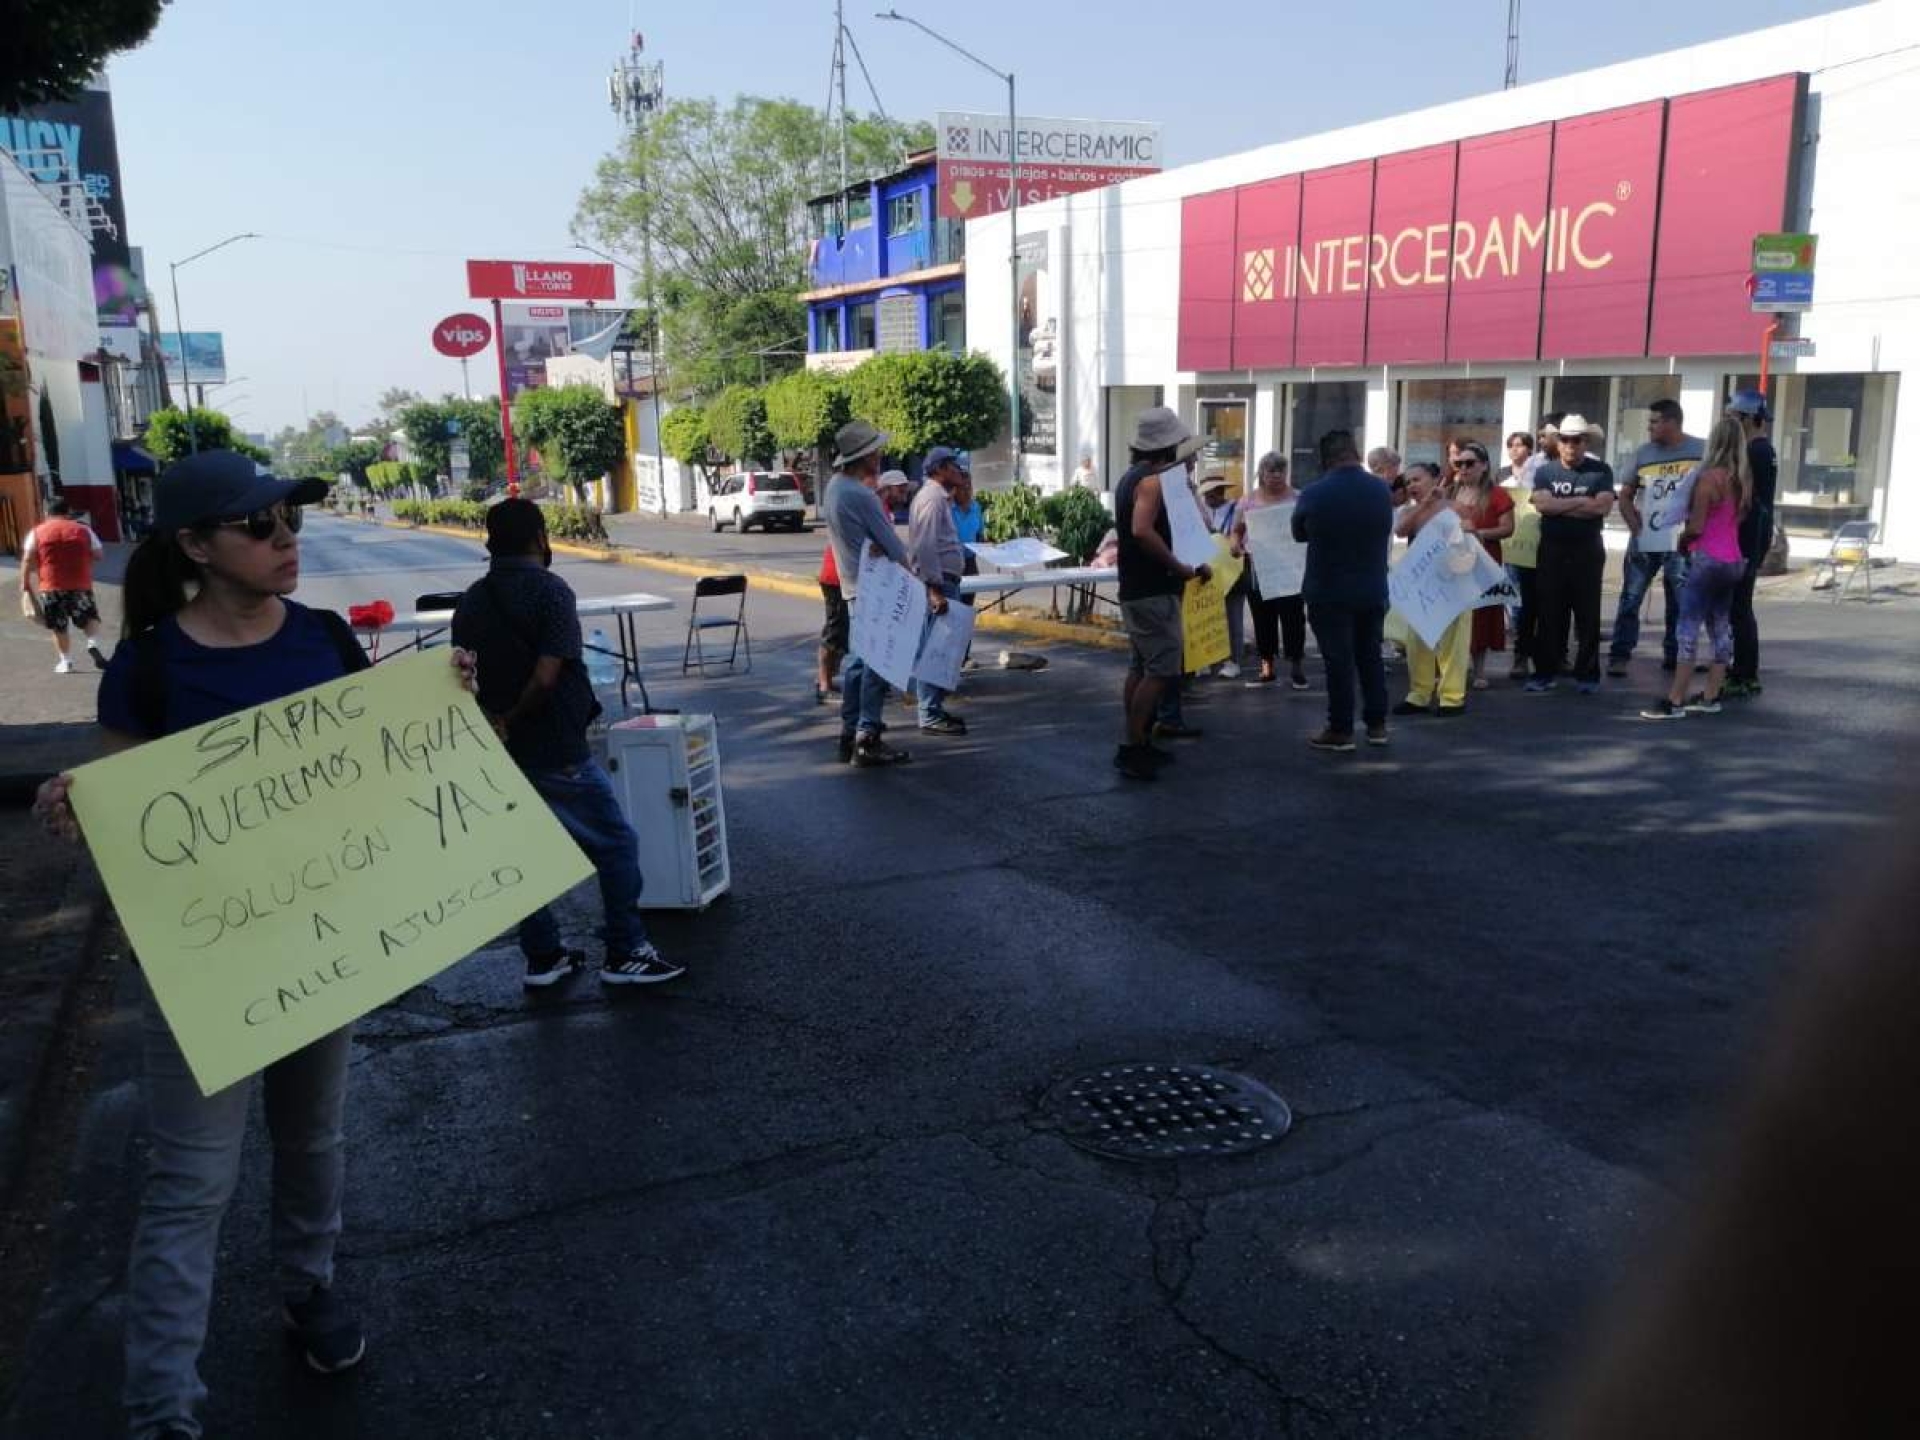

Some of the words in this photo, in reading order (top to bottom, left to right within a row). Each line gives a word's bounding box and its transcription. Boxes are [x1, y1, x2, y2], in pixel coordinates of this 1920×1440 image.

[978, 127, 1153, 160] INTERCERAMIC
[1284, 202, 1617, 299] INTERCERAMIC
[442, 325, 485, 347] vips
[1552, 482, 1572, 495] YO
[140, 746, 362, 866] QUEREMOS
[380, 703, 489, 775] AGUA
[179, 828, 392, 949] SOLUCIÓN
[407, 766, 518, 849] YA!
[243, 956, 360, 1027] CALLE
[377, 866, 524, 956] AJUSCO
[311, 912, 339, 941] A
